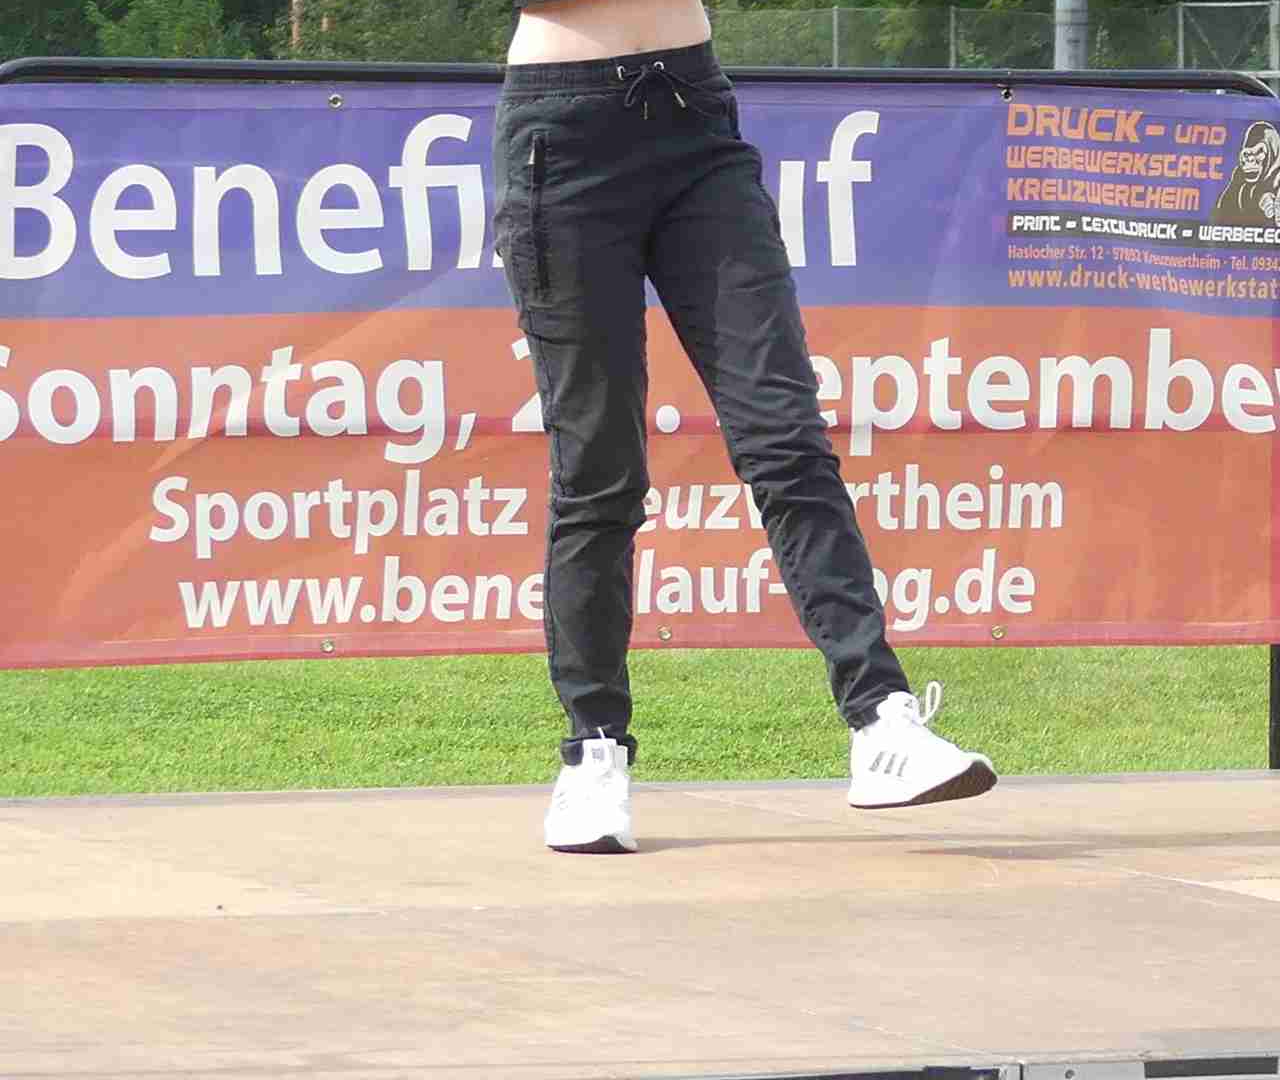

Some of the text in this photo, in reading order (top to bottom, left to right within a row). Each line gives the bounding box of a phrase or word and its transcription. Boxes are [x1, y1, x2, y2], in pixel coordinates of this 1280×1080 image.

[1007, 146, 1223, 181] WERBEWERKSTATT
[1007, 177, 1201, 211] KREUZWERTHEIM
[1012, 215, 1061, 232] PRINT
[1081, 217, 1178, 240] TEXTILDRUCK
[149, 468, 529, 559] Sportplatz
